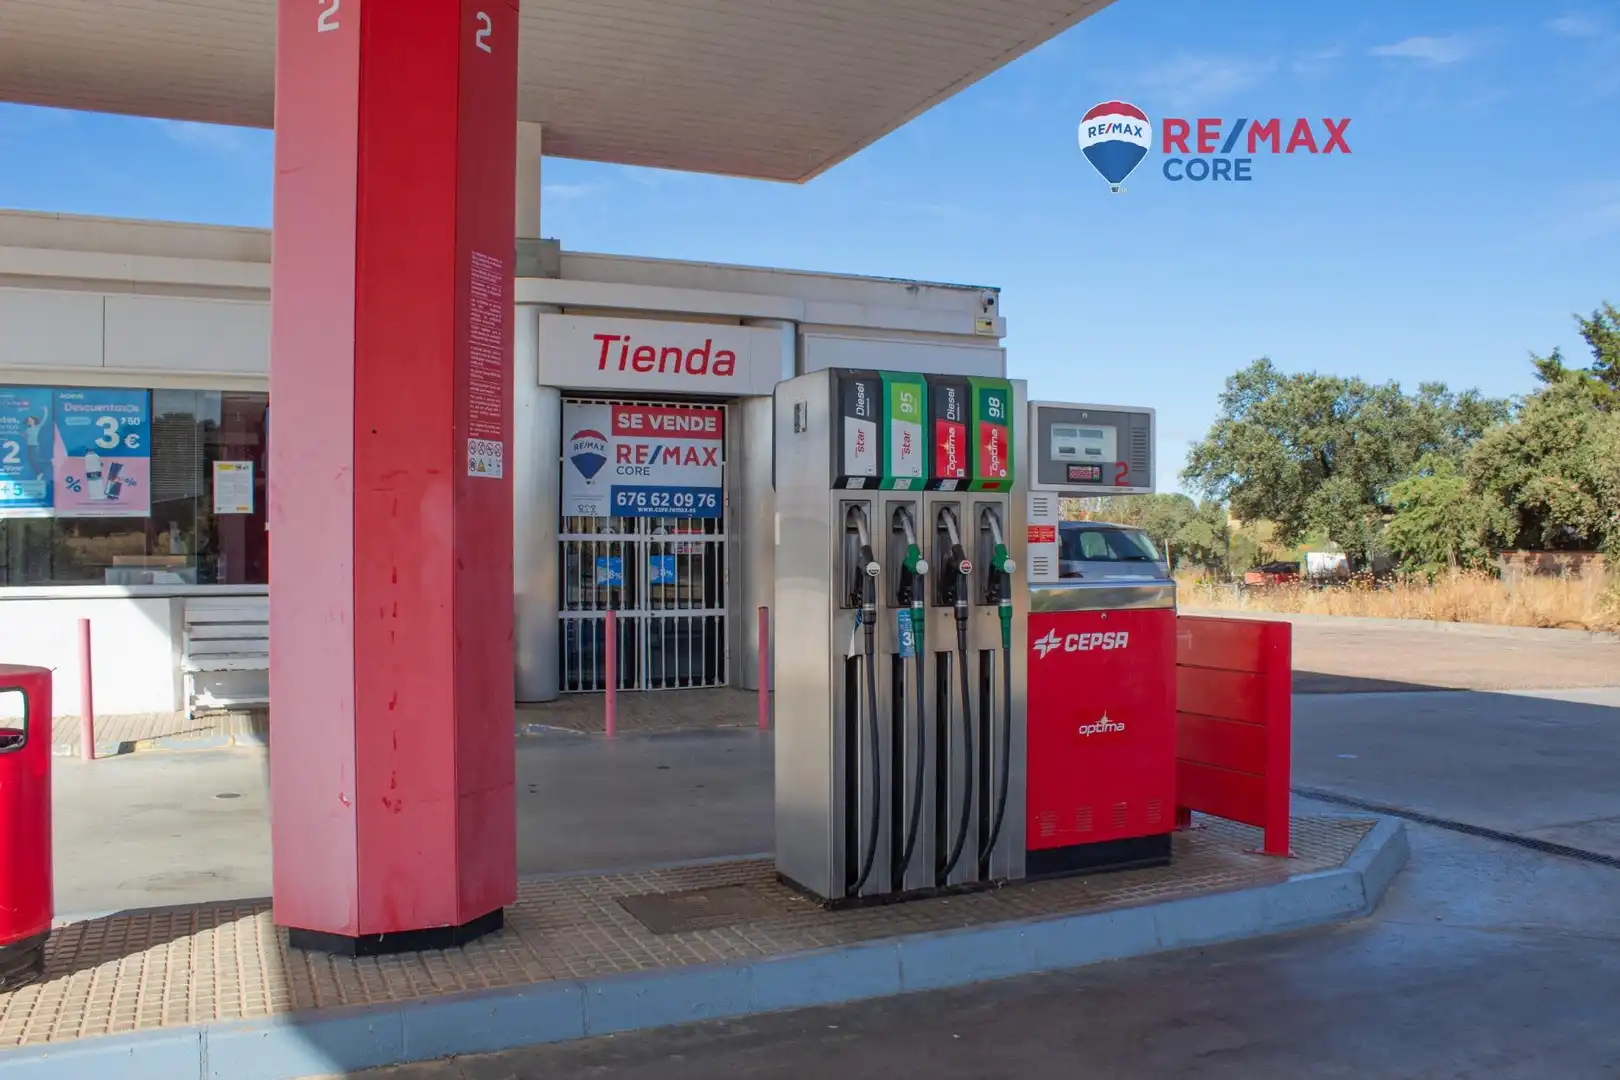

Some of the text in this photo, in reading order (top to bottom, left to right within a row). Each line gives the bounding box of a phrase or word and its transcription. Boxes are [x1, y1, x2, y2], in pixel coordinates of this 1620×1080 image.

[317, 0, 340, 33] 2
[475, 11, 492, 54] 2
[593, 333, 737, 377] Tienda
[855, 382, 865, 417] Diesel
[900, 391, 913, 414] 95
[945, 387, 956, 421] Diesel
[988, 396, 1000, 418] 98
[618, 412, 717, 432] SE VENDE
[574, 440, 605, 452] RE/MAX
[856, 428, 865, 453] star
[903, 430, 911, 455] star
[947, 427, 957, 471] optima
[991, 428, 1000, 471] optima
[616, 444, 718, 467] RE/MAX
[616, 466, 651, 476] CORE
[1115, 460, 1130, 486] 2
[616, 492, 647, 506] 676
[650, 492, 670, 507] 62
[673, 493, 694, 507] 09
[697, 493, 716, 508] 76
[1064, 631, 1129, 652] CEPSA
[1078, 721, 1125, 737] optima
